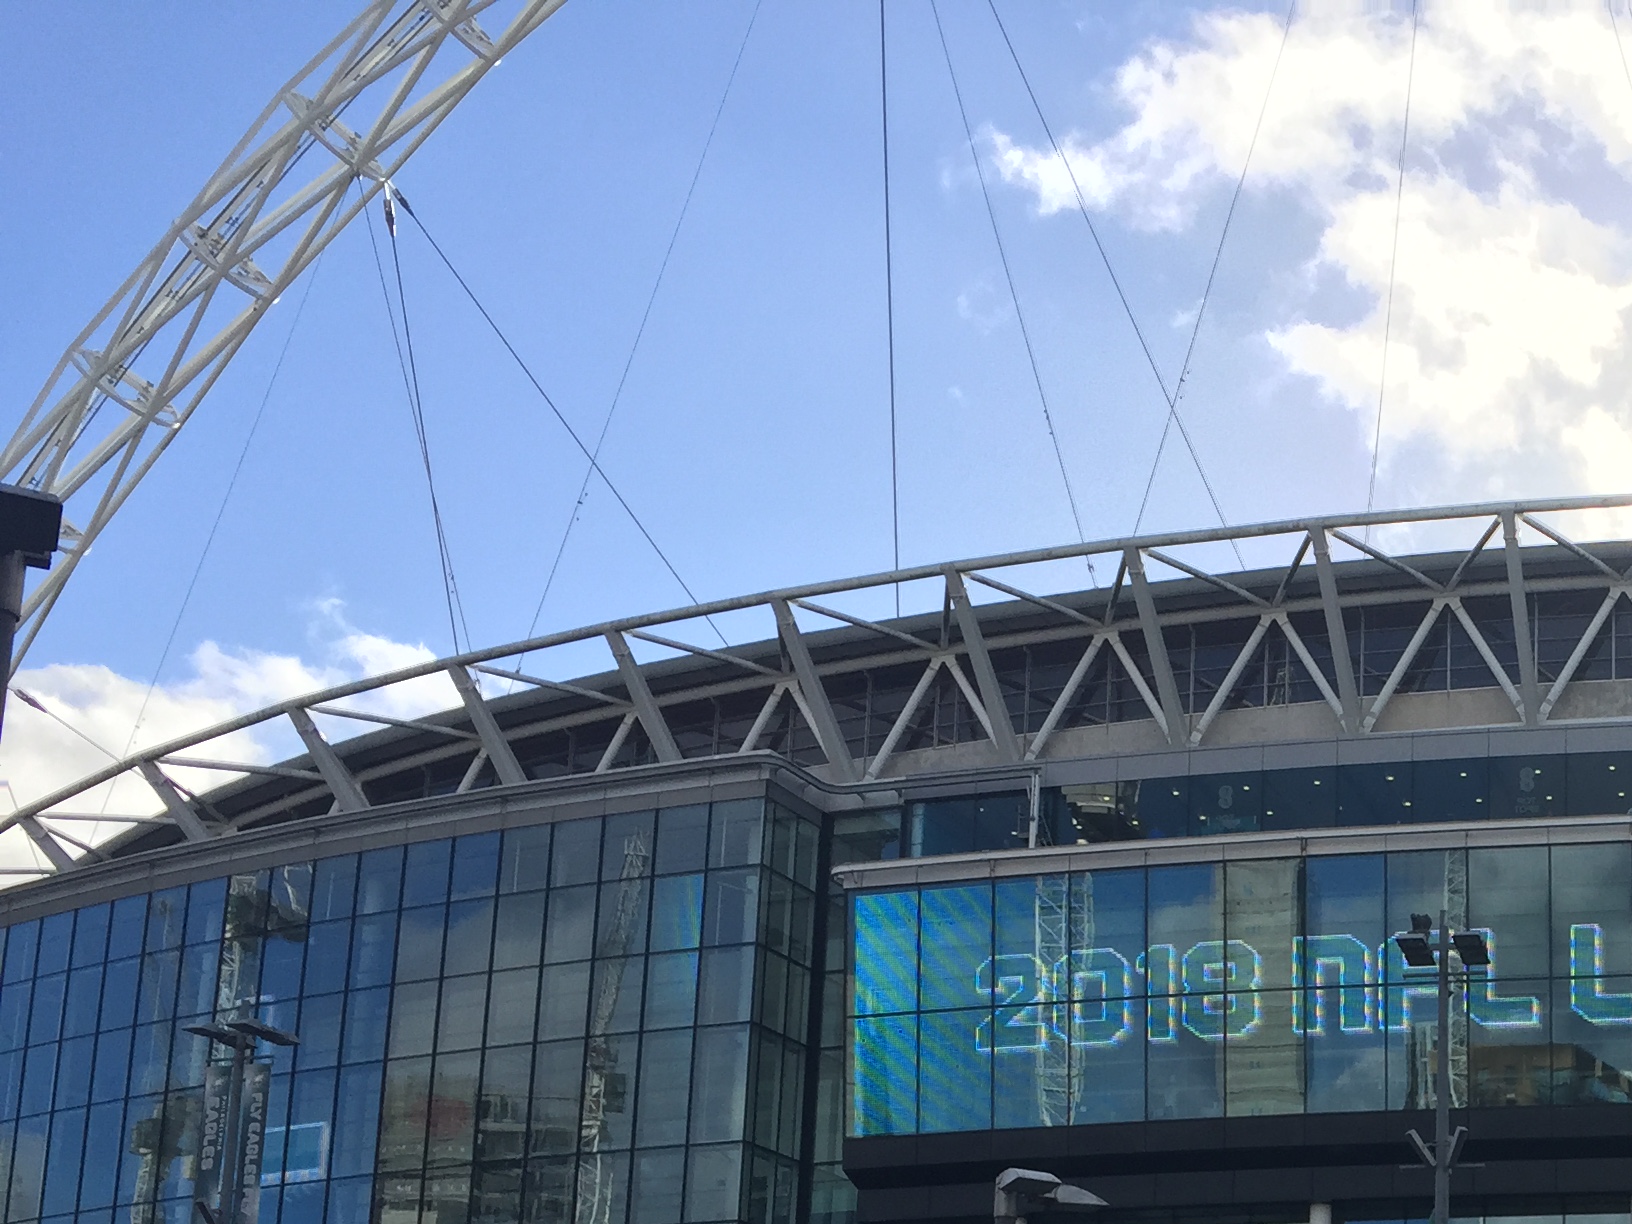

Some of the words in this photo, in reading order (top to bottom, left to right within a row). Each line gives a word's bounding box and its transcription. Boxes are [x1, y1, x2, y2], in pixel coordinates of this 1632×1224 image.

[975, 939, 1263, 1053] 2018
[201, 1096, 220, 1171] EAGLES
[243, 1122, 261, 1185] EAGLES
